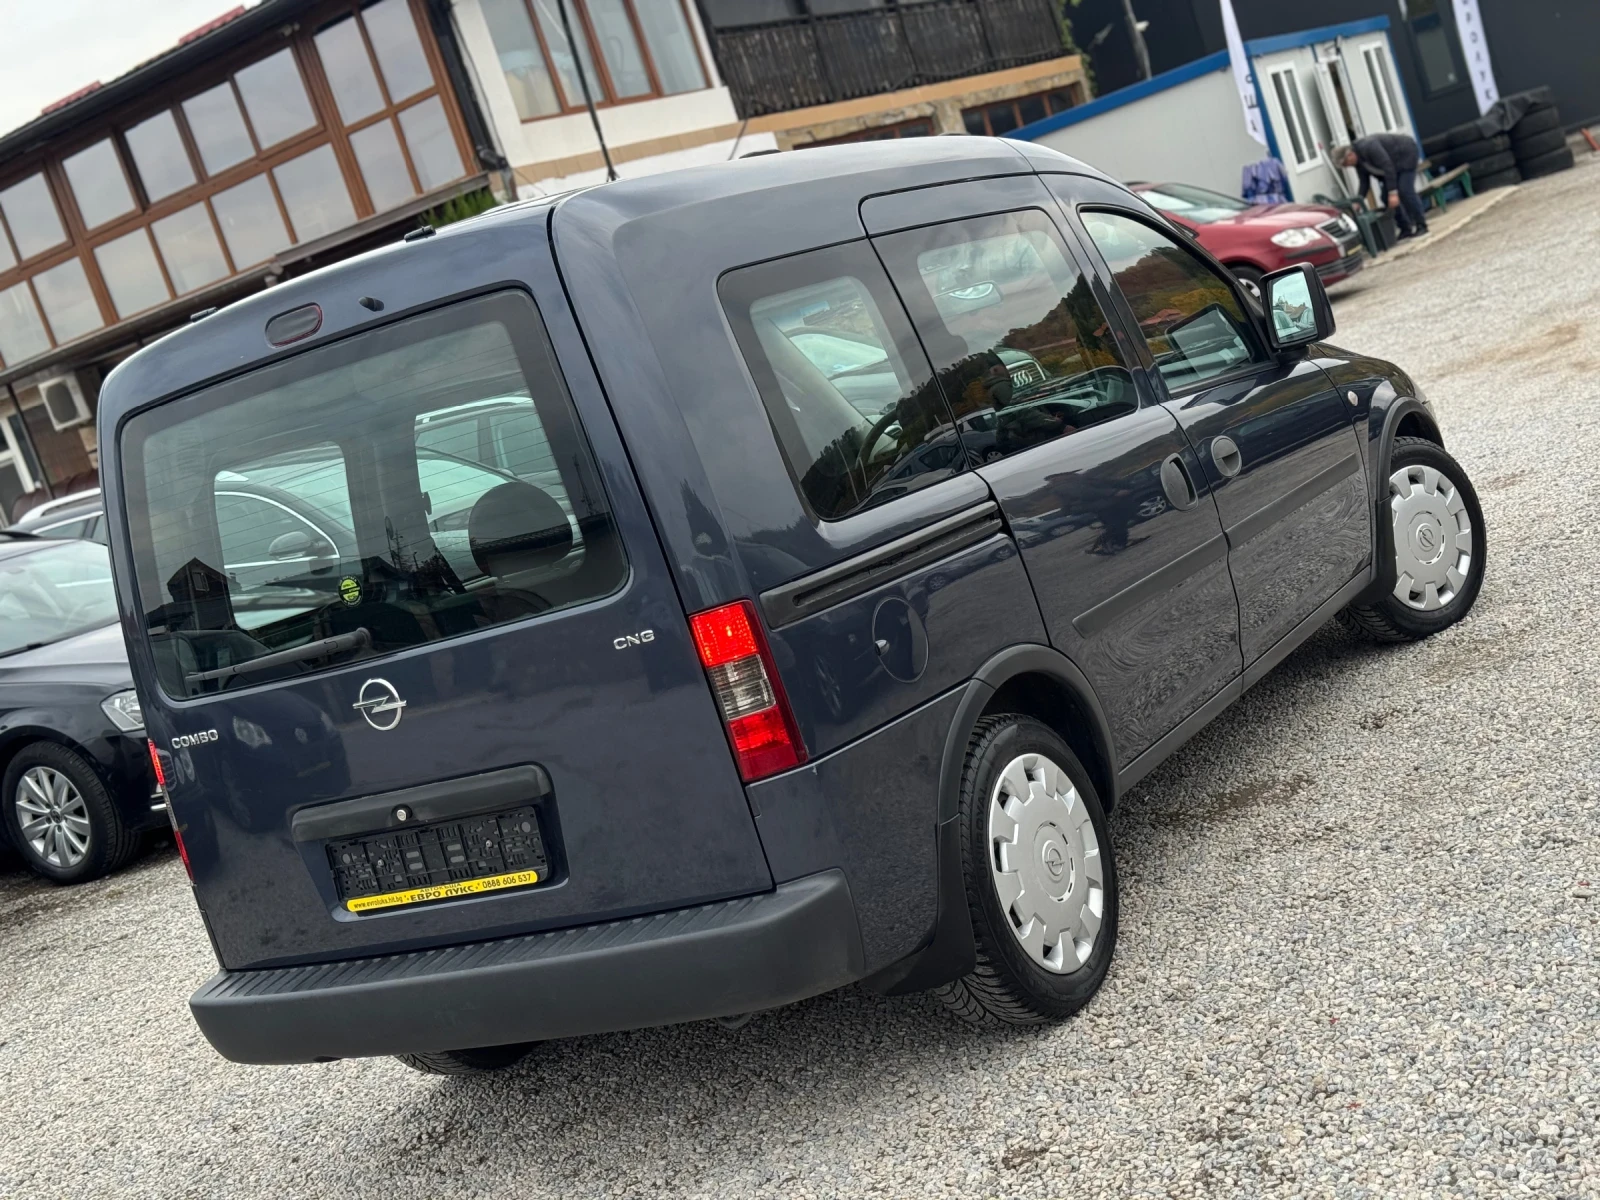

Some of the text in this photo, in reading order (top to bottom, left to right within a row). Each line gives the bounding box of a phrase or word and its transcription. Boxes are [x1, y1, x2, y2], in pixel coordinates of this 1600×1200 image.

[613, 629, 655, 650] CNG
[171, 729, 219, 749] COMBO
[975, 786, 989, 880] UNIROYAL
[482, 873, 531, 889] 0888 606 537
[410, 890, 441, 902] ЕВРО
